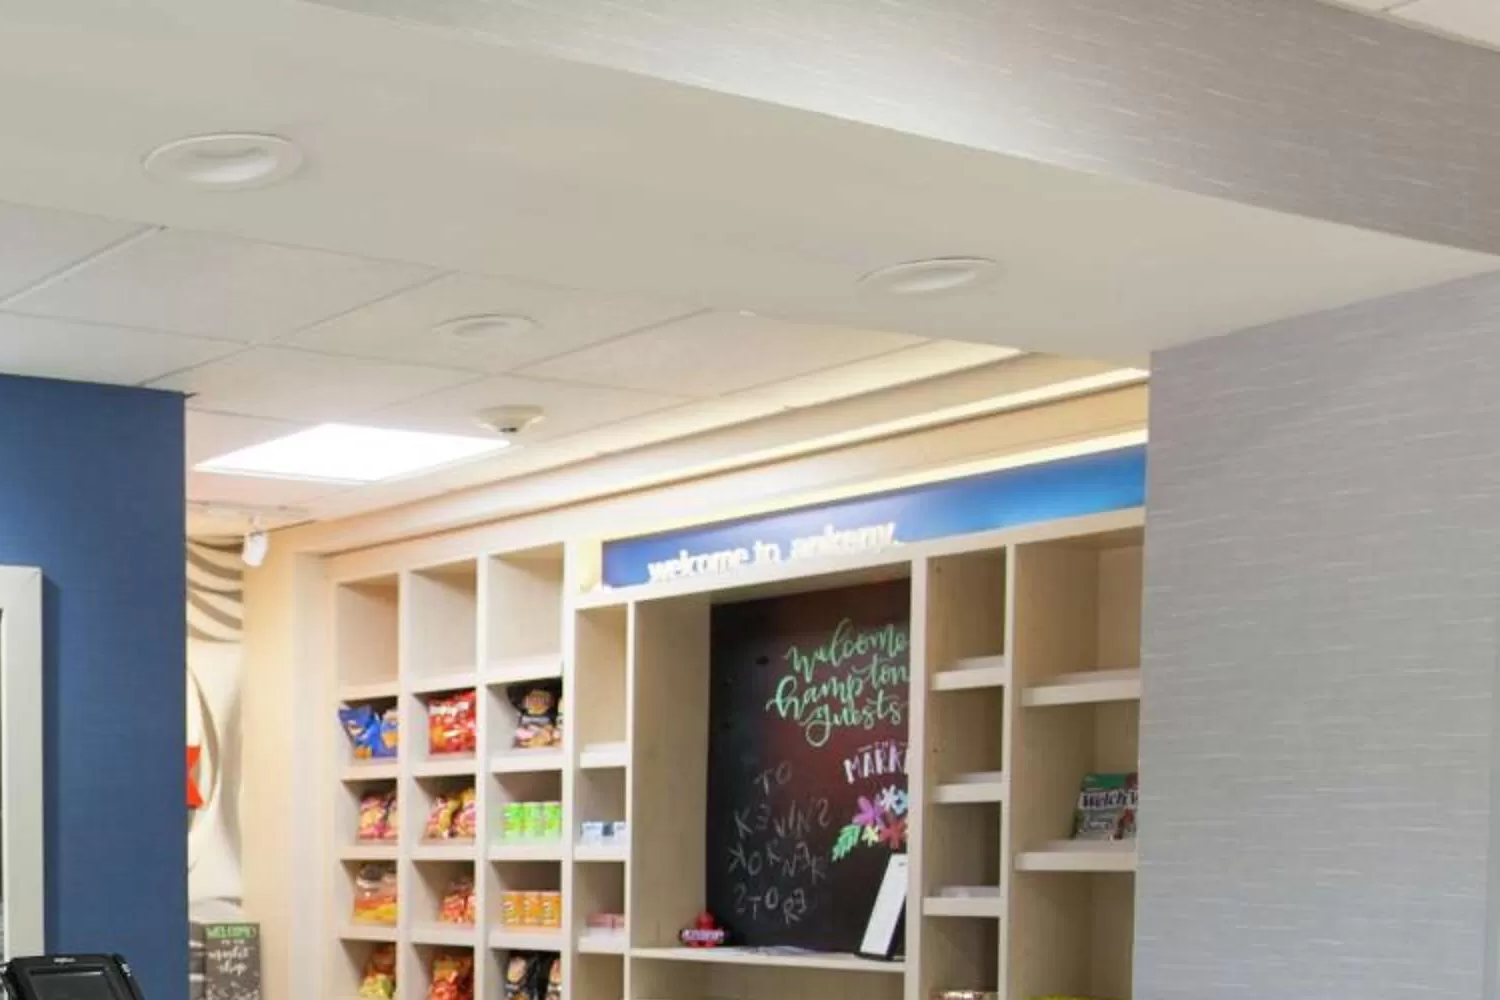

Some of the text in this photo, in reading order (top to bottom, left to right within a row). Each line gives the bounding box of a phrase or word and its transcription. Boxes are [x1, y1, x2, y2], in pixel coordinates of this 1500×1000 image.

[647, 549, 749, 584] welcome
[752, 540, 781, 564] to
[781, 618, 910, 683] welcome
[763, 653, 910, 720] hampton
[798, 689, 909, 747] guests
